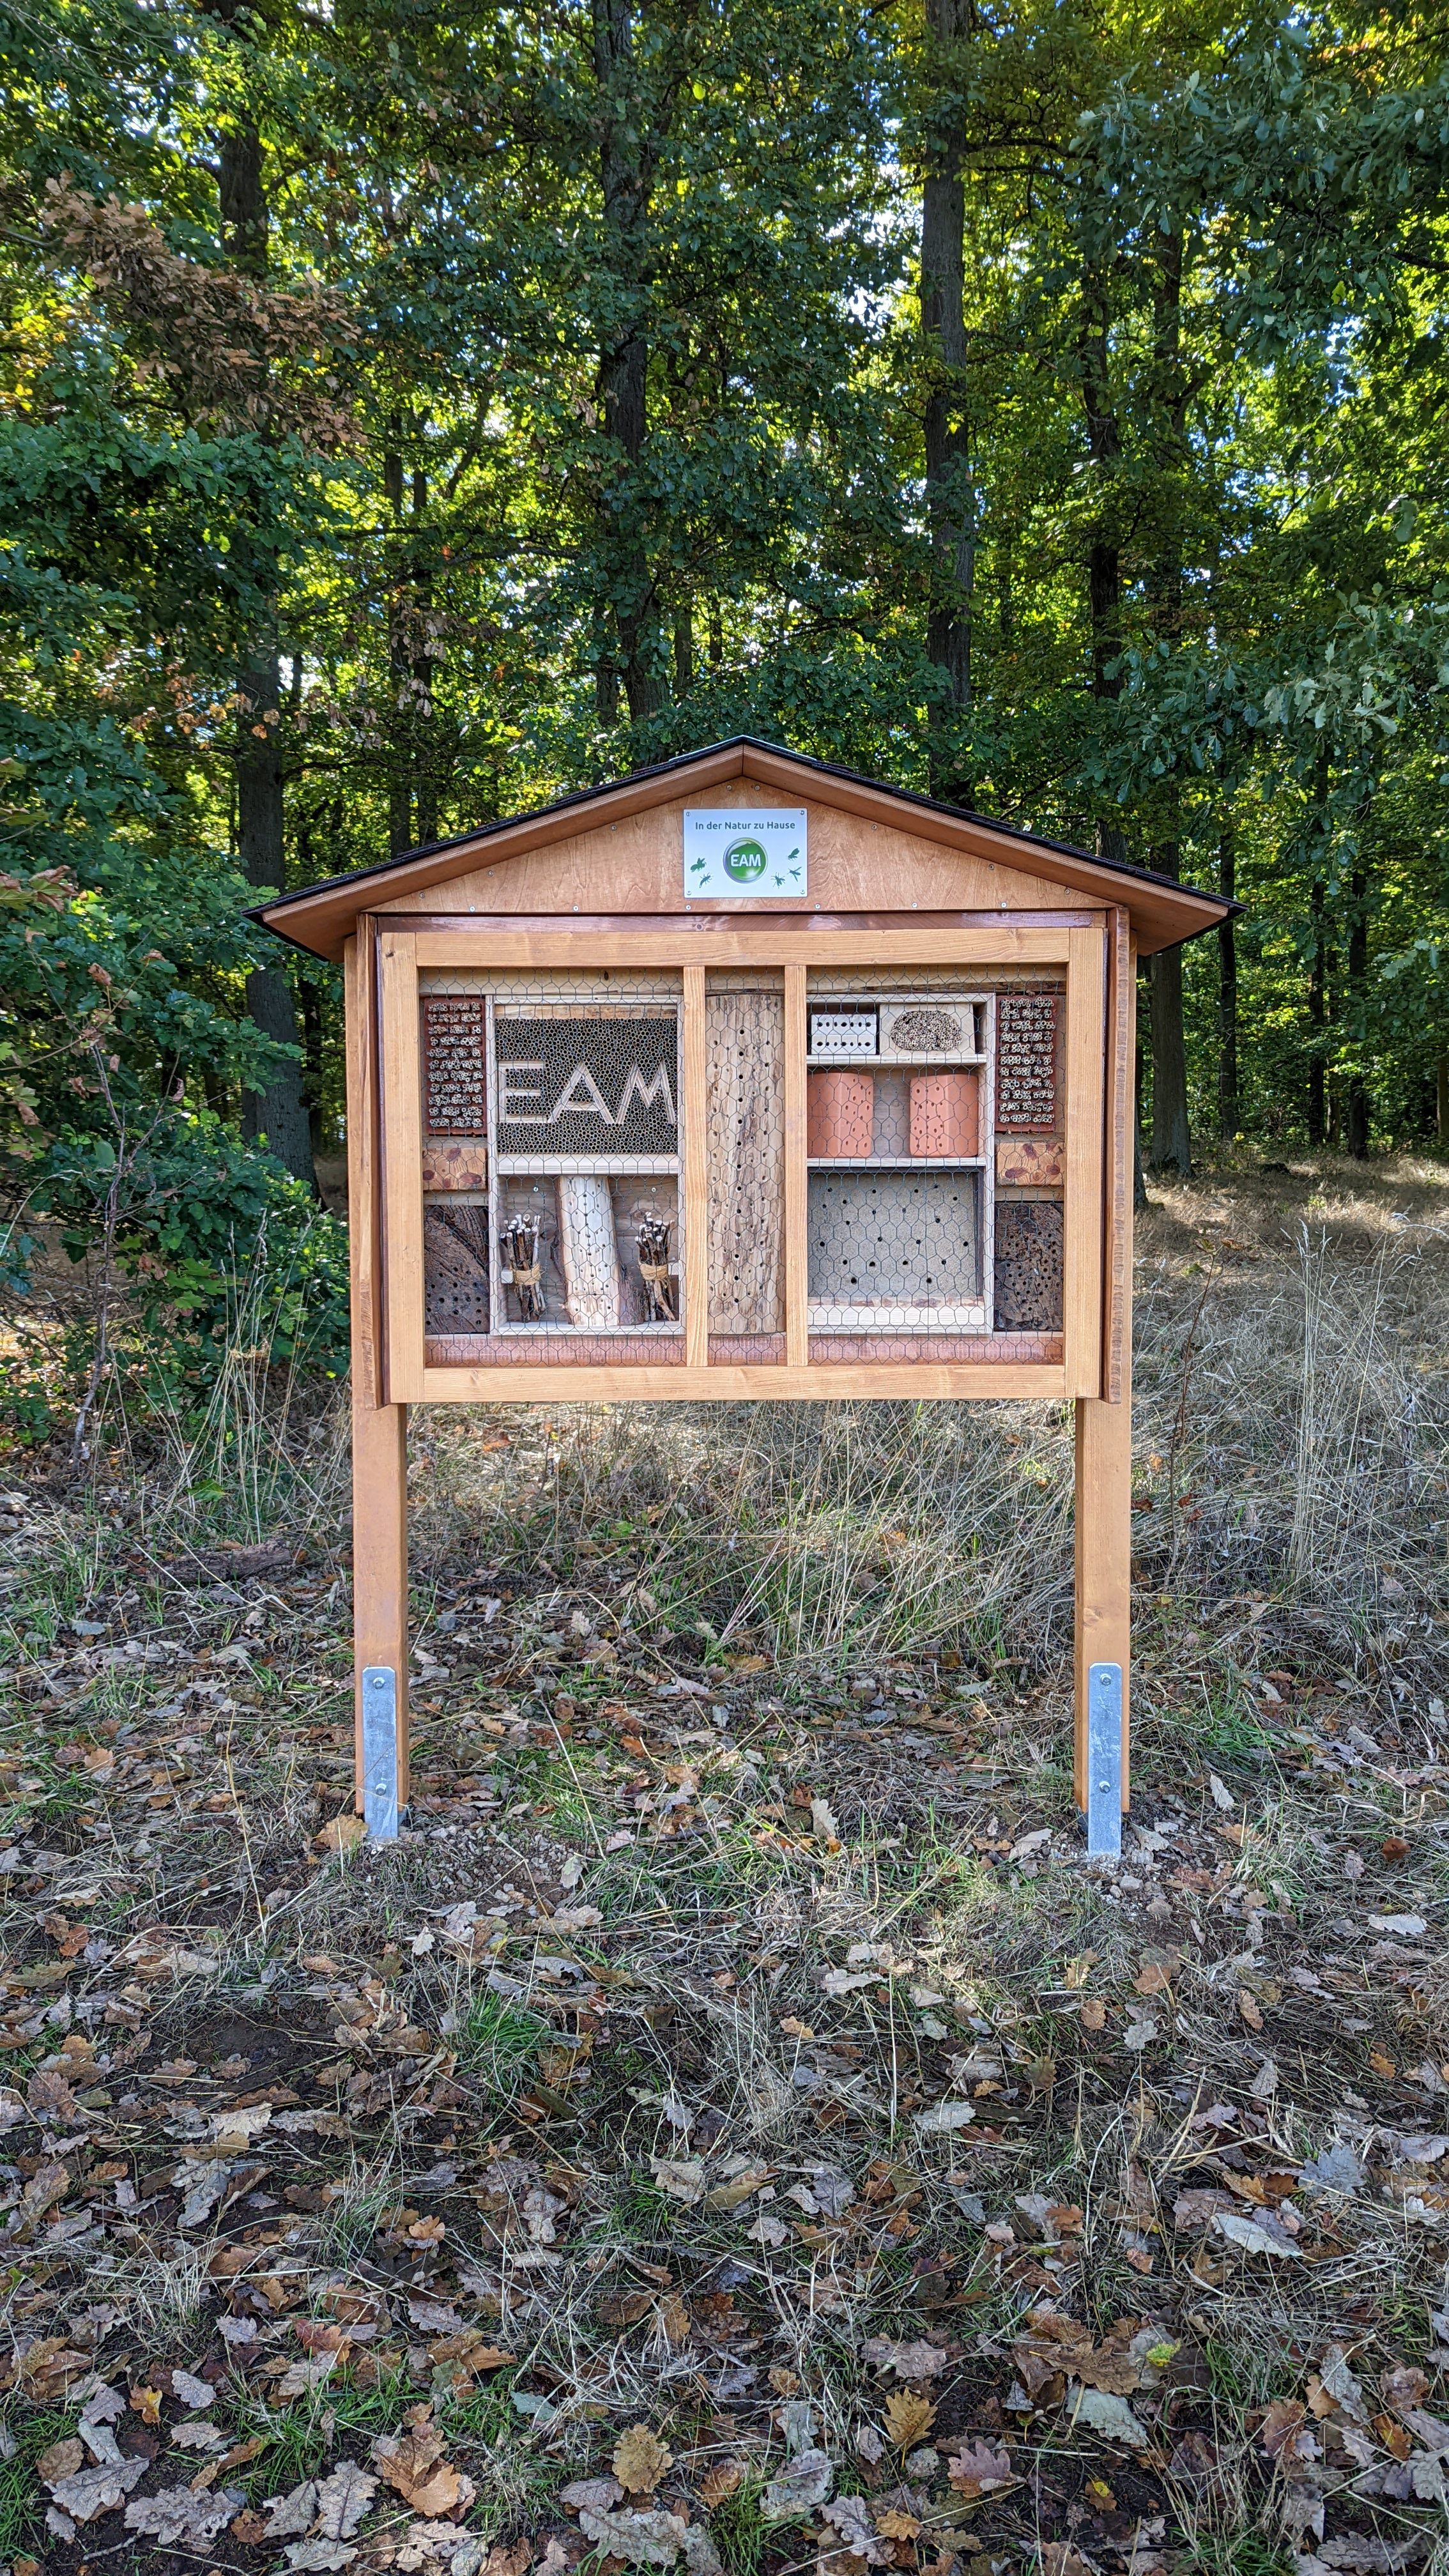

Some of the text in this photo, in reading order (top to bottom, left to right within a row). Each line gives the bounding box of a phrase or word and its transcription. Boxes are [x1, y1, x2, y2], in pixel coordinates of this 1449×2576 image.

[695, 822, 703, 830] In
[707, 822, 723, 830] der
[730, 854, 762, 867] EAM
[497, 1059, 676, 1124] EAM
